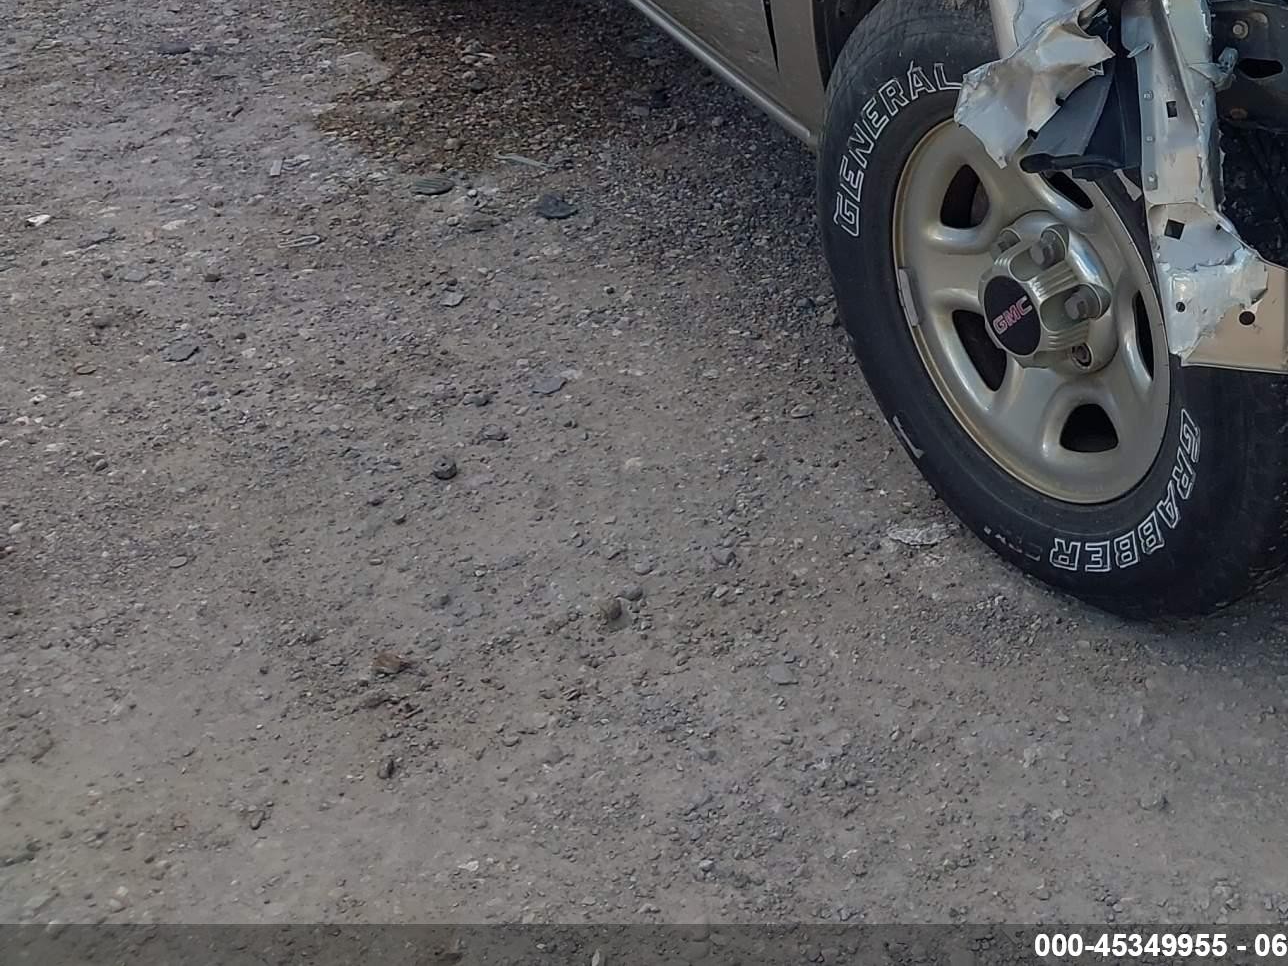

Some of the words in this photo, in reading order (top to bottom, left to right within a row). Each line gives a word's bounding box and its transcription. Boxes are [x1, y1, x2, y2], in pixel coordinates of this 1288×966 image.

[833, 60, 963, 237] GENERAL
[992, 295, 1033, 335] GMC
[1050, 409, 1200, 572] GRABBER
